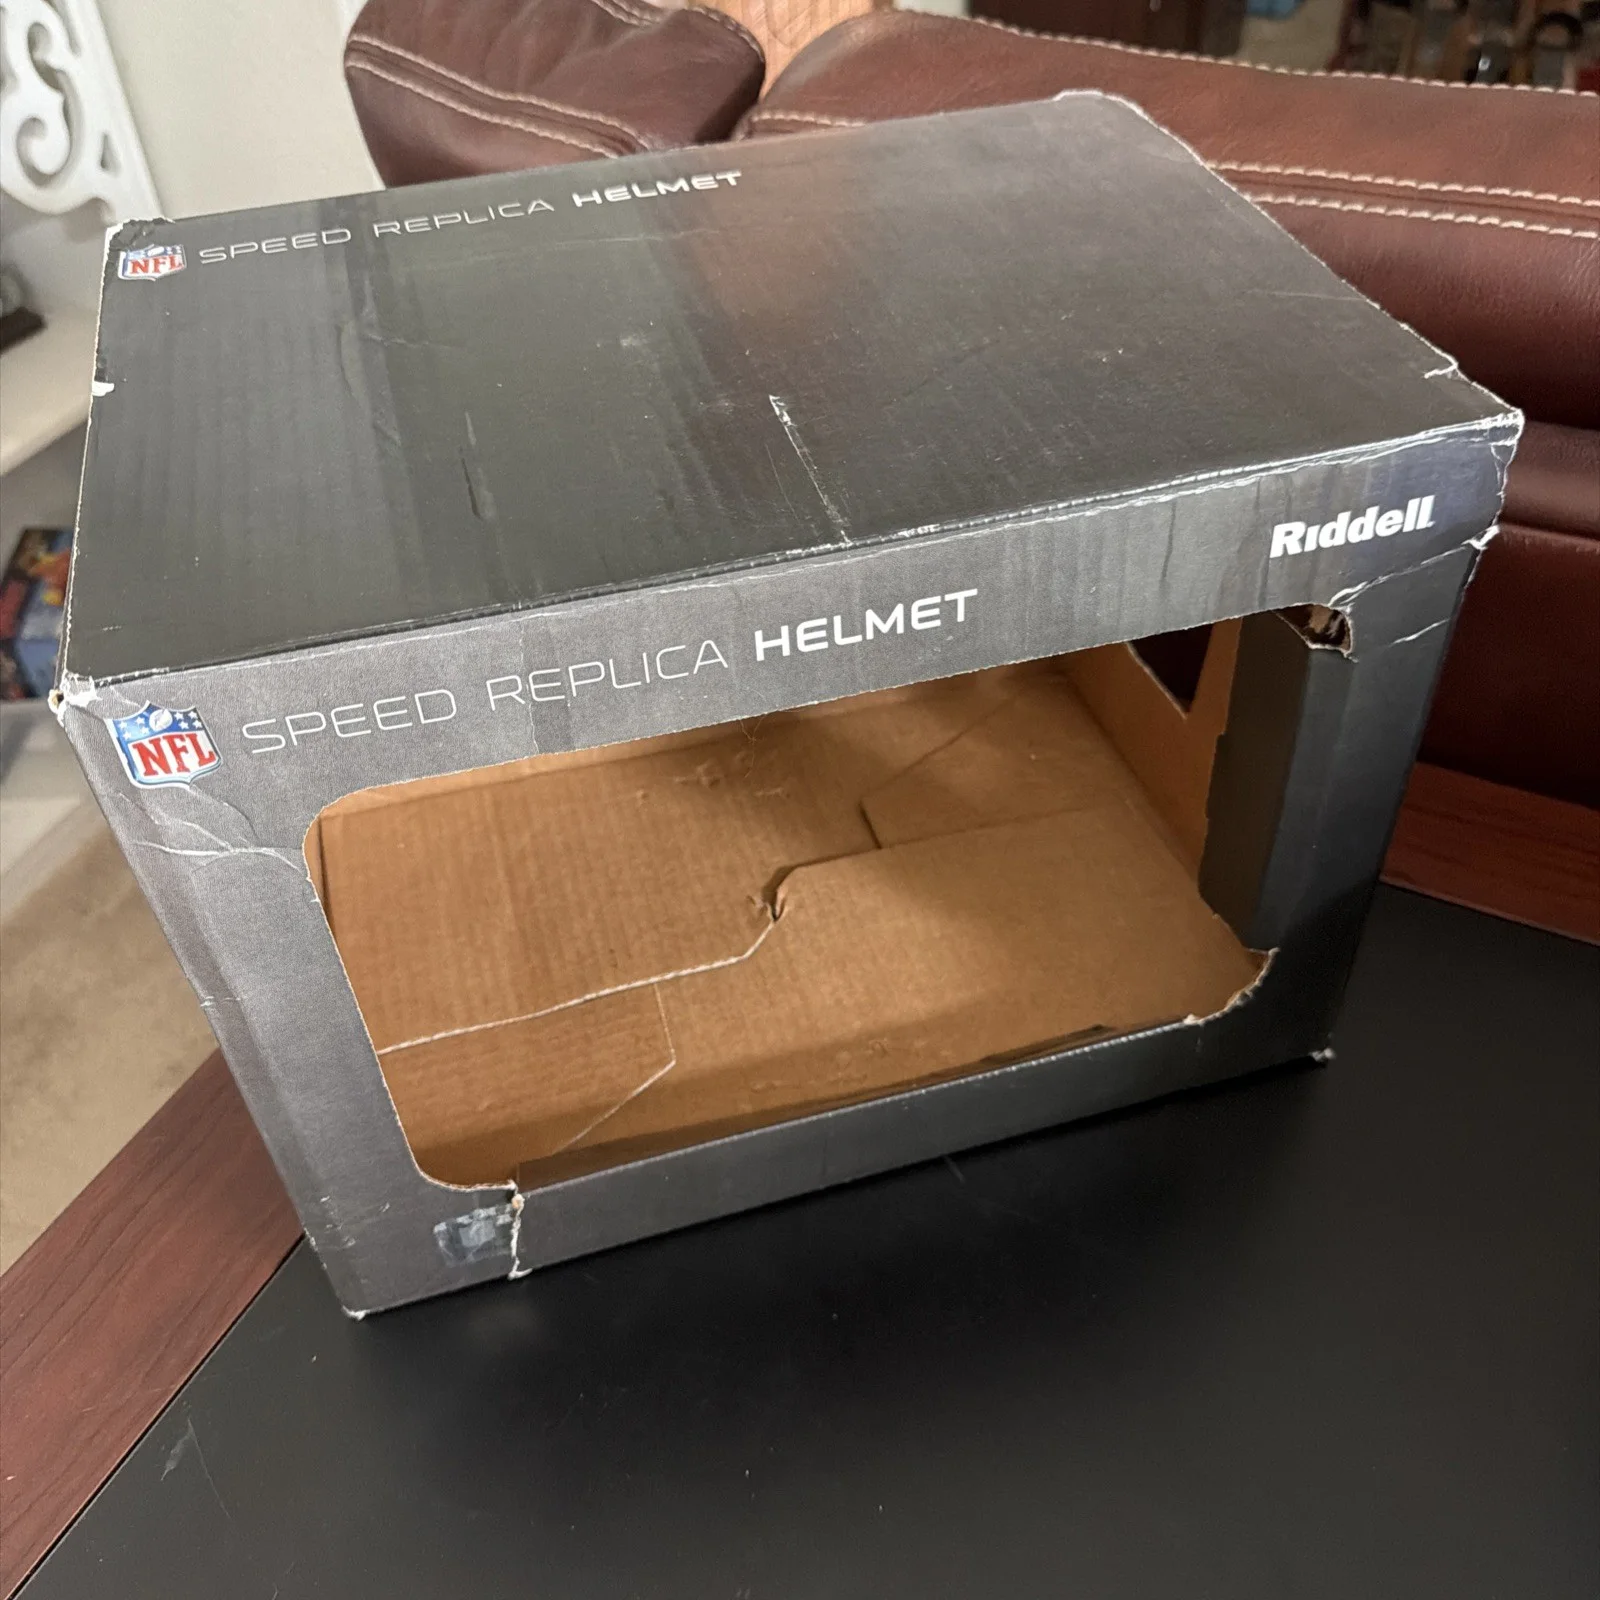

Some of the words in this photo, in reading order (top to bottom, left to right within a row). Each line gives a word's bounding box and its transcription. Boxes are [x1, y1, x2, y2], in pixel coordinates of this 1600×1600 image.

[199, 227, 352, 265] SPEED
[373, 197, 554, 239] REPLICA
[572, 170, 742, 208] HELMET
[129, 254, 184, 277] NFL
[242, 689, 457, 754] SPEED
[486, 639, 728, 711] REPLICA
[755, 588, 978, 661] HELMET
[132, 731, 217, 777] NFL
